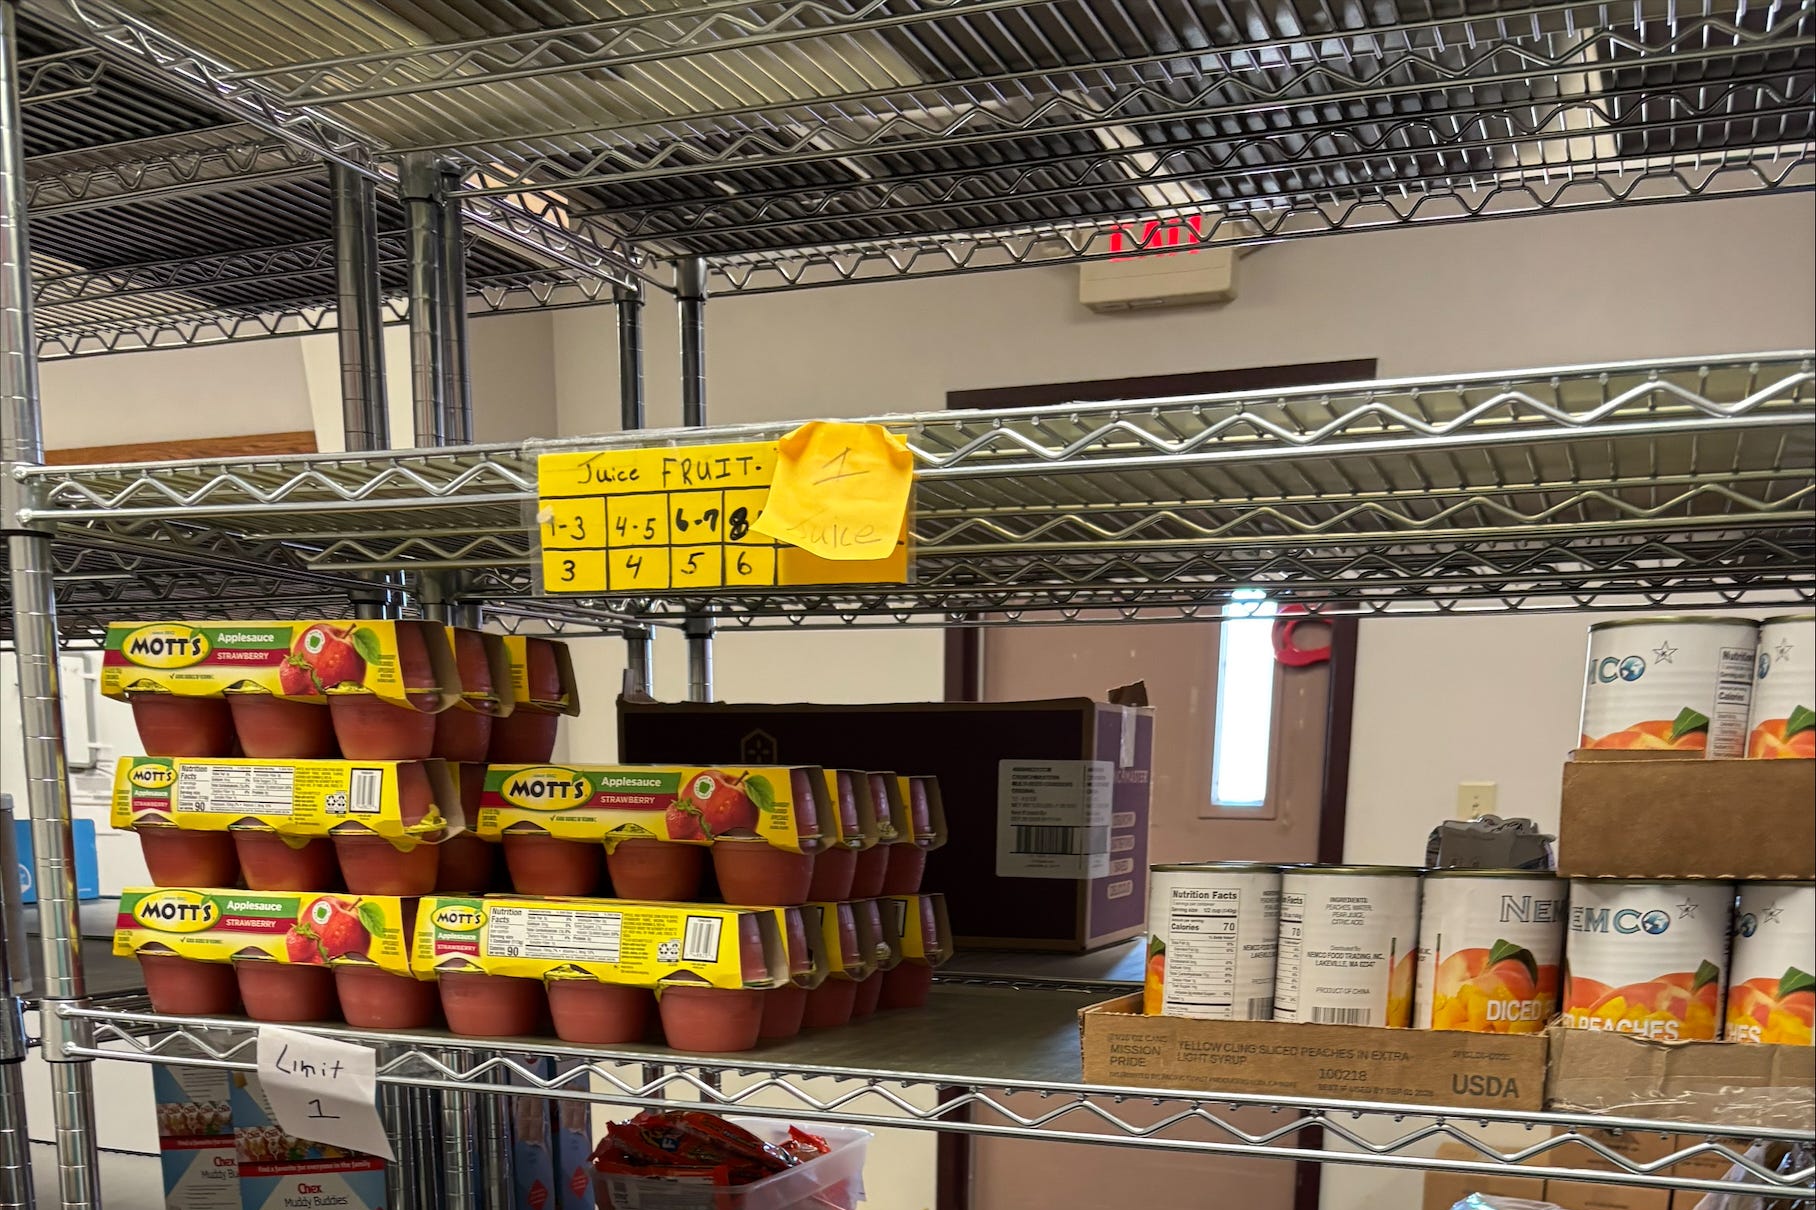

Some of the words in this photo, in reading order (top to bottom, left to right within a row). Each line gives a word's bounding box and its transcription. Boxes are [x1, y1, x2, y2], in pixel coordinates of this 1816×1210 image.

[577, 452, 640, 485] Juice
[675, 508, 718, 533] 6-7
[728, 505, 762, 542] 8
[560, 559, 576, 582] 3
[625, 555, 643, 579] 4
[680, 552, 705, 575] 5
[736, 552, 752, 575] 6
[217, 632, 275, 644] Applesauce
[130, 637, 201, 656] MOTT'S
[217, 652, 270, 660] STRAWBERRY
[133, 770, 172, 781] MOTT'S
[600, 776, 662, 788] Applesauce
[509, 779, 583, 799] MOTT'S
[600, 796, 656, 804] STRAWBERRY
[194, 801, 205, 812] 90
[1172, 890, 1210, 899] Nutrition
[1212, 891, 1238, 900] Facts
[141, 900, 212, 922] MOTT'S
[226, 900, 283, 912] Applesauce
[491, 907, 523, 916] Nutrition
[226, 919, 277, 928] STRAWBERRY
[436, 912, 481, 925] MOTT'S
[491, 916, 510, 924] Facts
[1571, 906, 1671, 934] EMCO
[1171, 923, 1200, 931] Calories
[1223, 922, 1235, 931] 70
[507, 946, 519, 956] 90
[1486, 1000, 1541, 1021] DICED
[1110, 1044, 1161, 1056] MISSION
[1177, 1040, 1222, 1052] YELLOW
[1223, 1043, 1256, 1054] CLING
[1258, 1045, 1298, 1056] SLICED
[1300, 1046, 1354, 1059] PEACHES
[1357, 1050, 1369, 1060] IN
[1109, 1056, 1146, 1067] PRIDE
[1177, 1052, 1208, 1063] LIGHT
[1209, 1054, 1248, 1066] SYRUP
[1317, 1068, 1368, 1081] 100218
[1451, 1073, 1520, 1098] USDA
[284, 1197, 312, 1209] Muddy
[313, 1195, 349, 1207] Buddies
